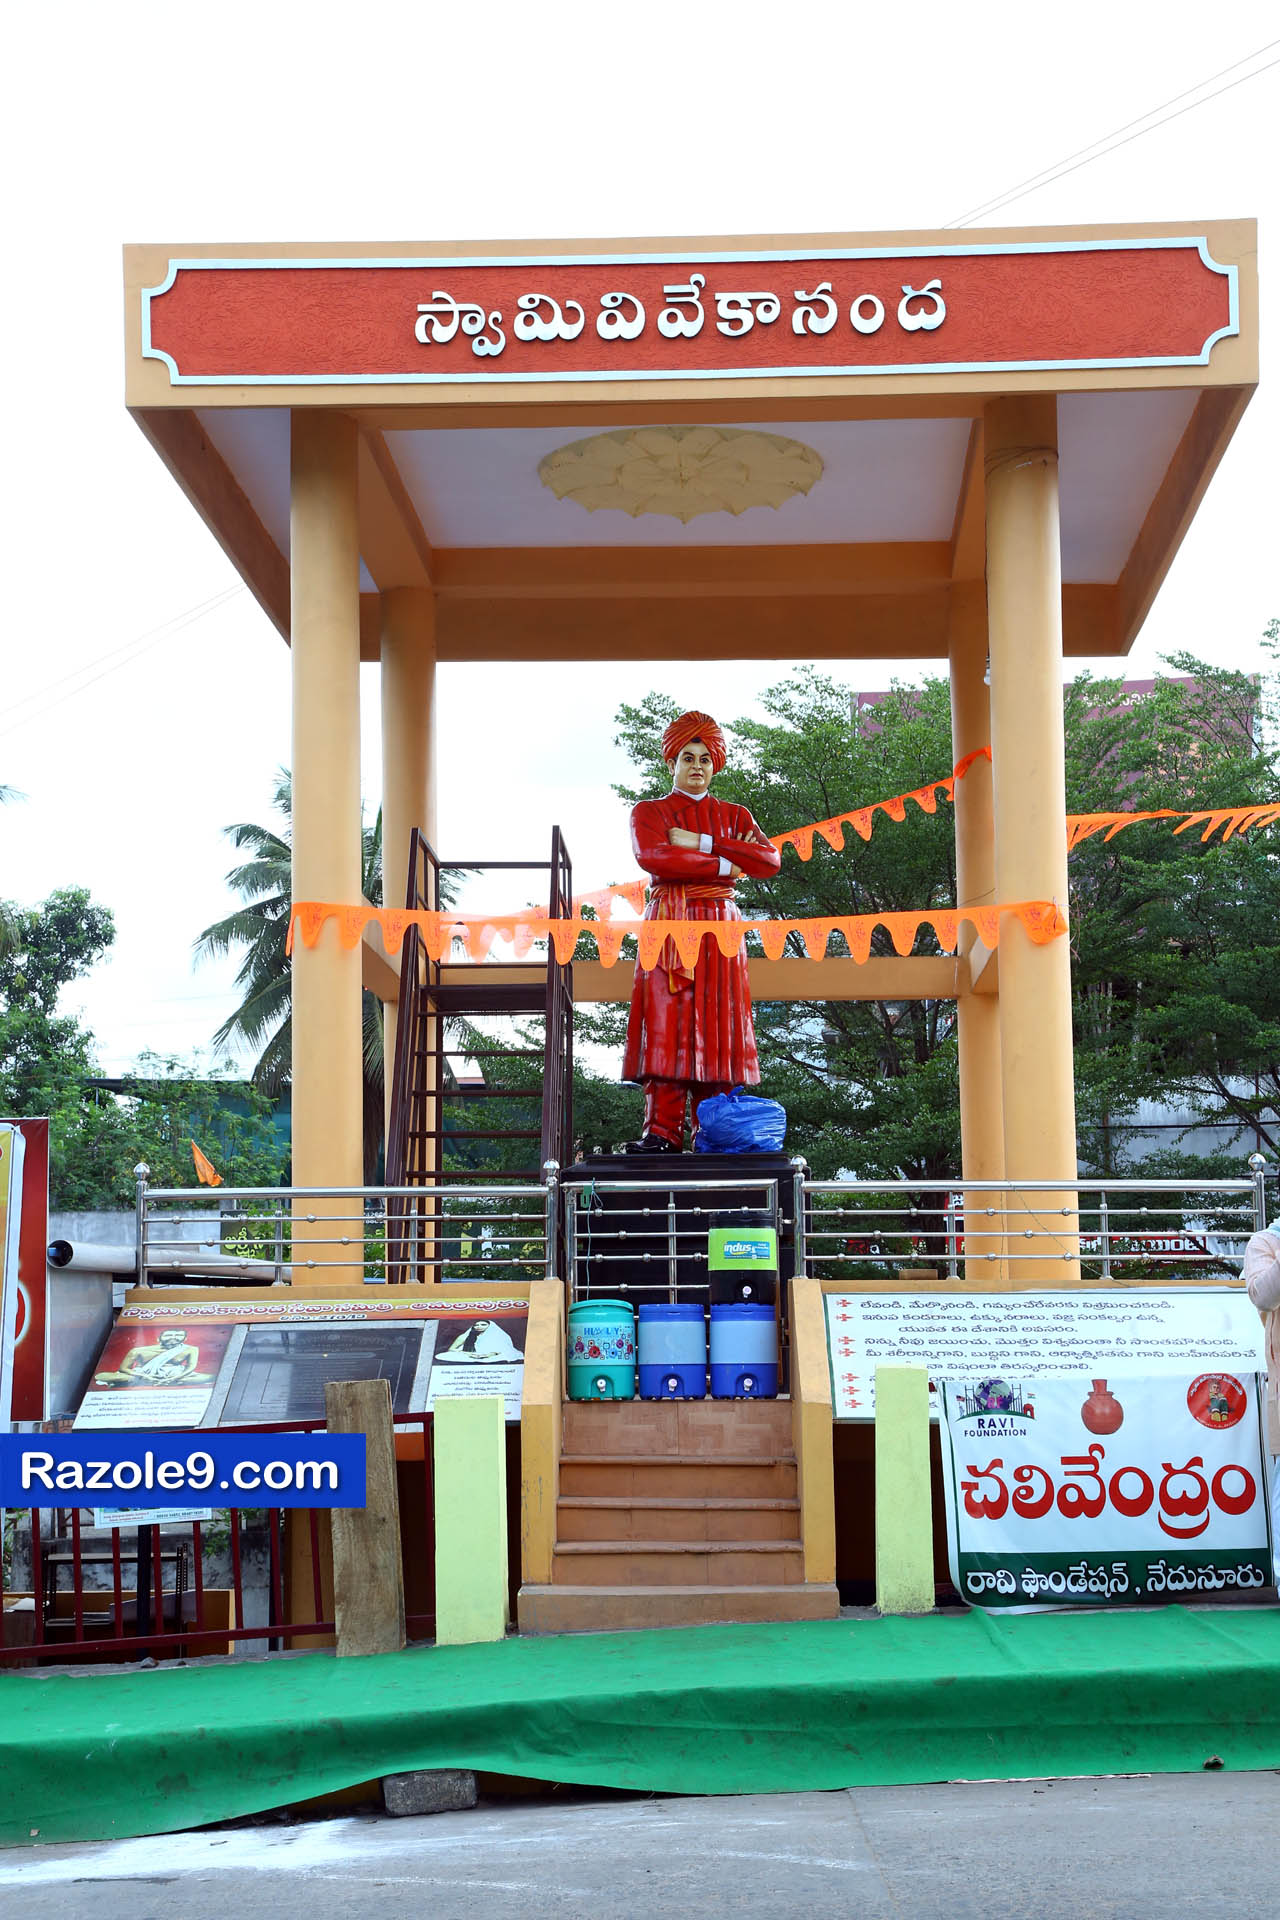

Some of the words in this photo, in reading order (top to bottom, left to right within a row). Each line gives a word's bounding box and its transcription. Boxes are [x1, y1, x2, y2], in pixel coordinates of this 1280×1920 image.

[963, 1428, 1027, 1438] FOUNDATION
[977, 1418, 1015, 1430] RAVI
[960, 1443, 1257, 1540] చలివేంద్రం
[966, 1568, 1017, 1595] రావి
[1146, 1559, 1265, 1593] నేదునూరు
